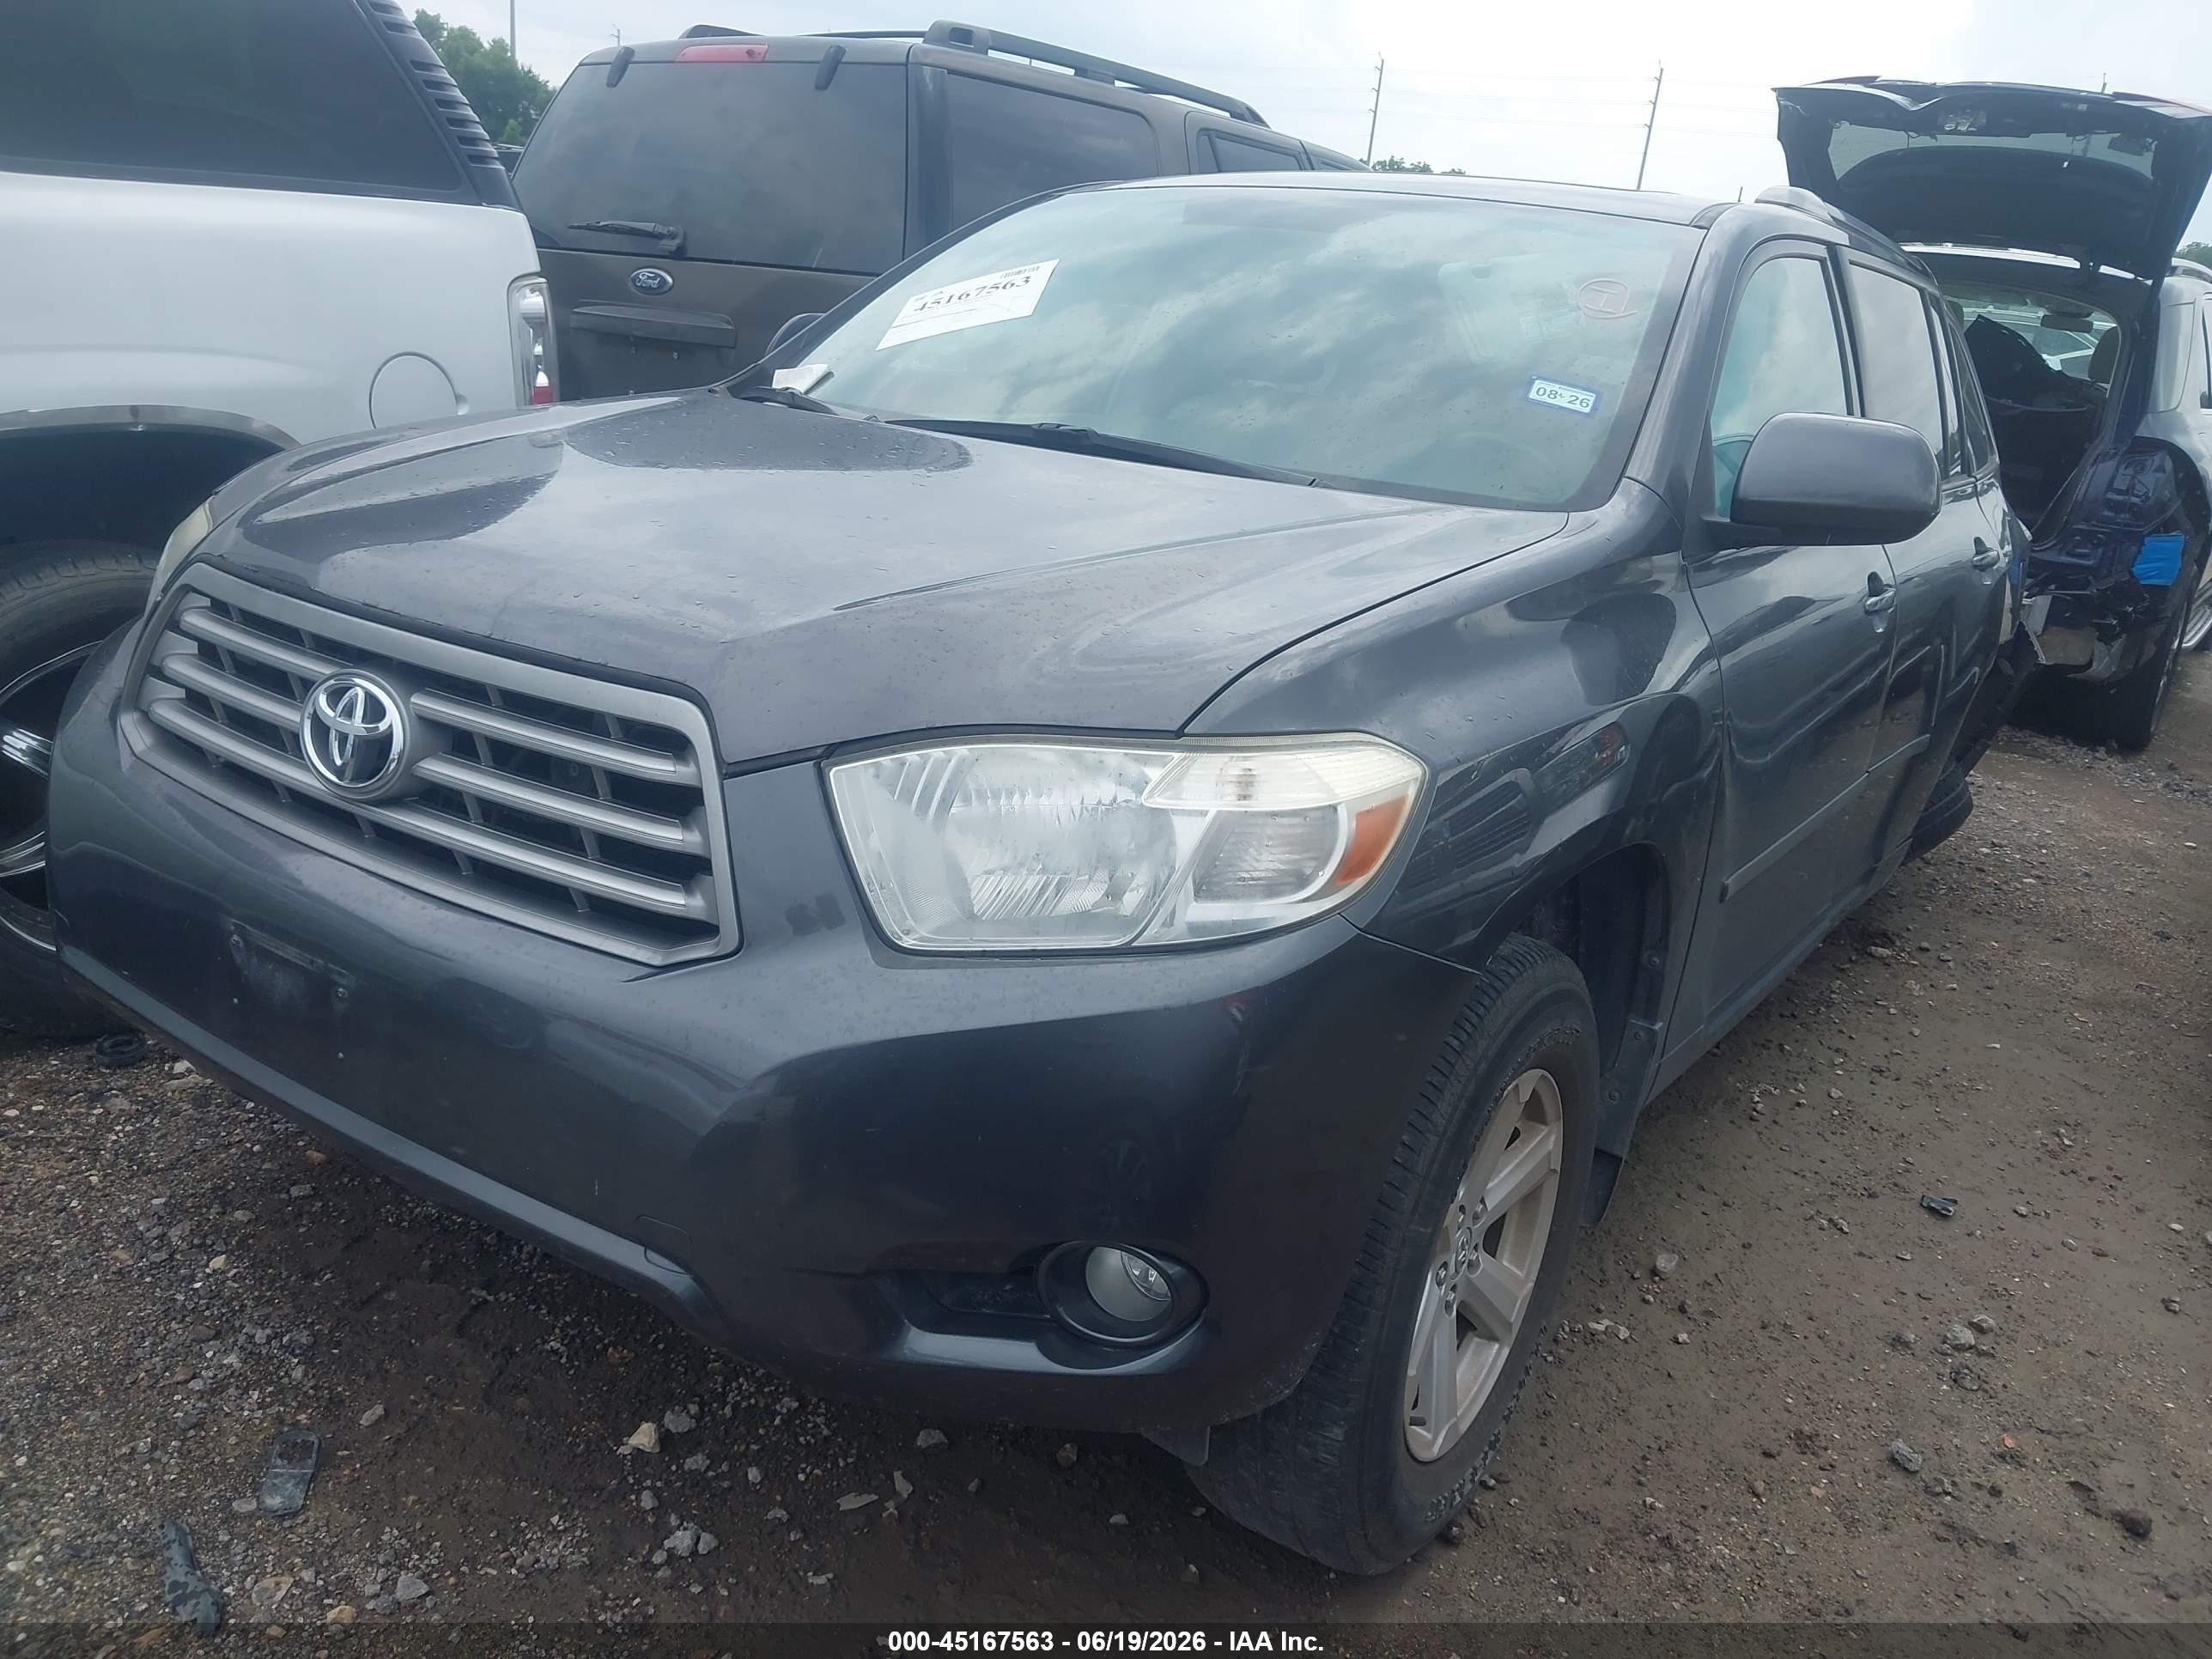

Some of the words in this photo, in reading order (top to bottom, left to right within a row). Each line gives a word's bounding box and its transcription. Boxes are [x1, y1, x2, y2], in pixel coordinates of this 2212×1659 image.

[635, 271, 661, 289] Ford
[914, 275, 1031, 312] 45167563
[1535, 386, 1559, 400] 08
[1567, 395, 1591, 408] 26
